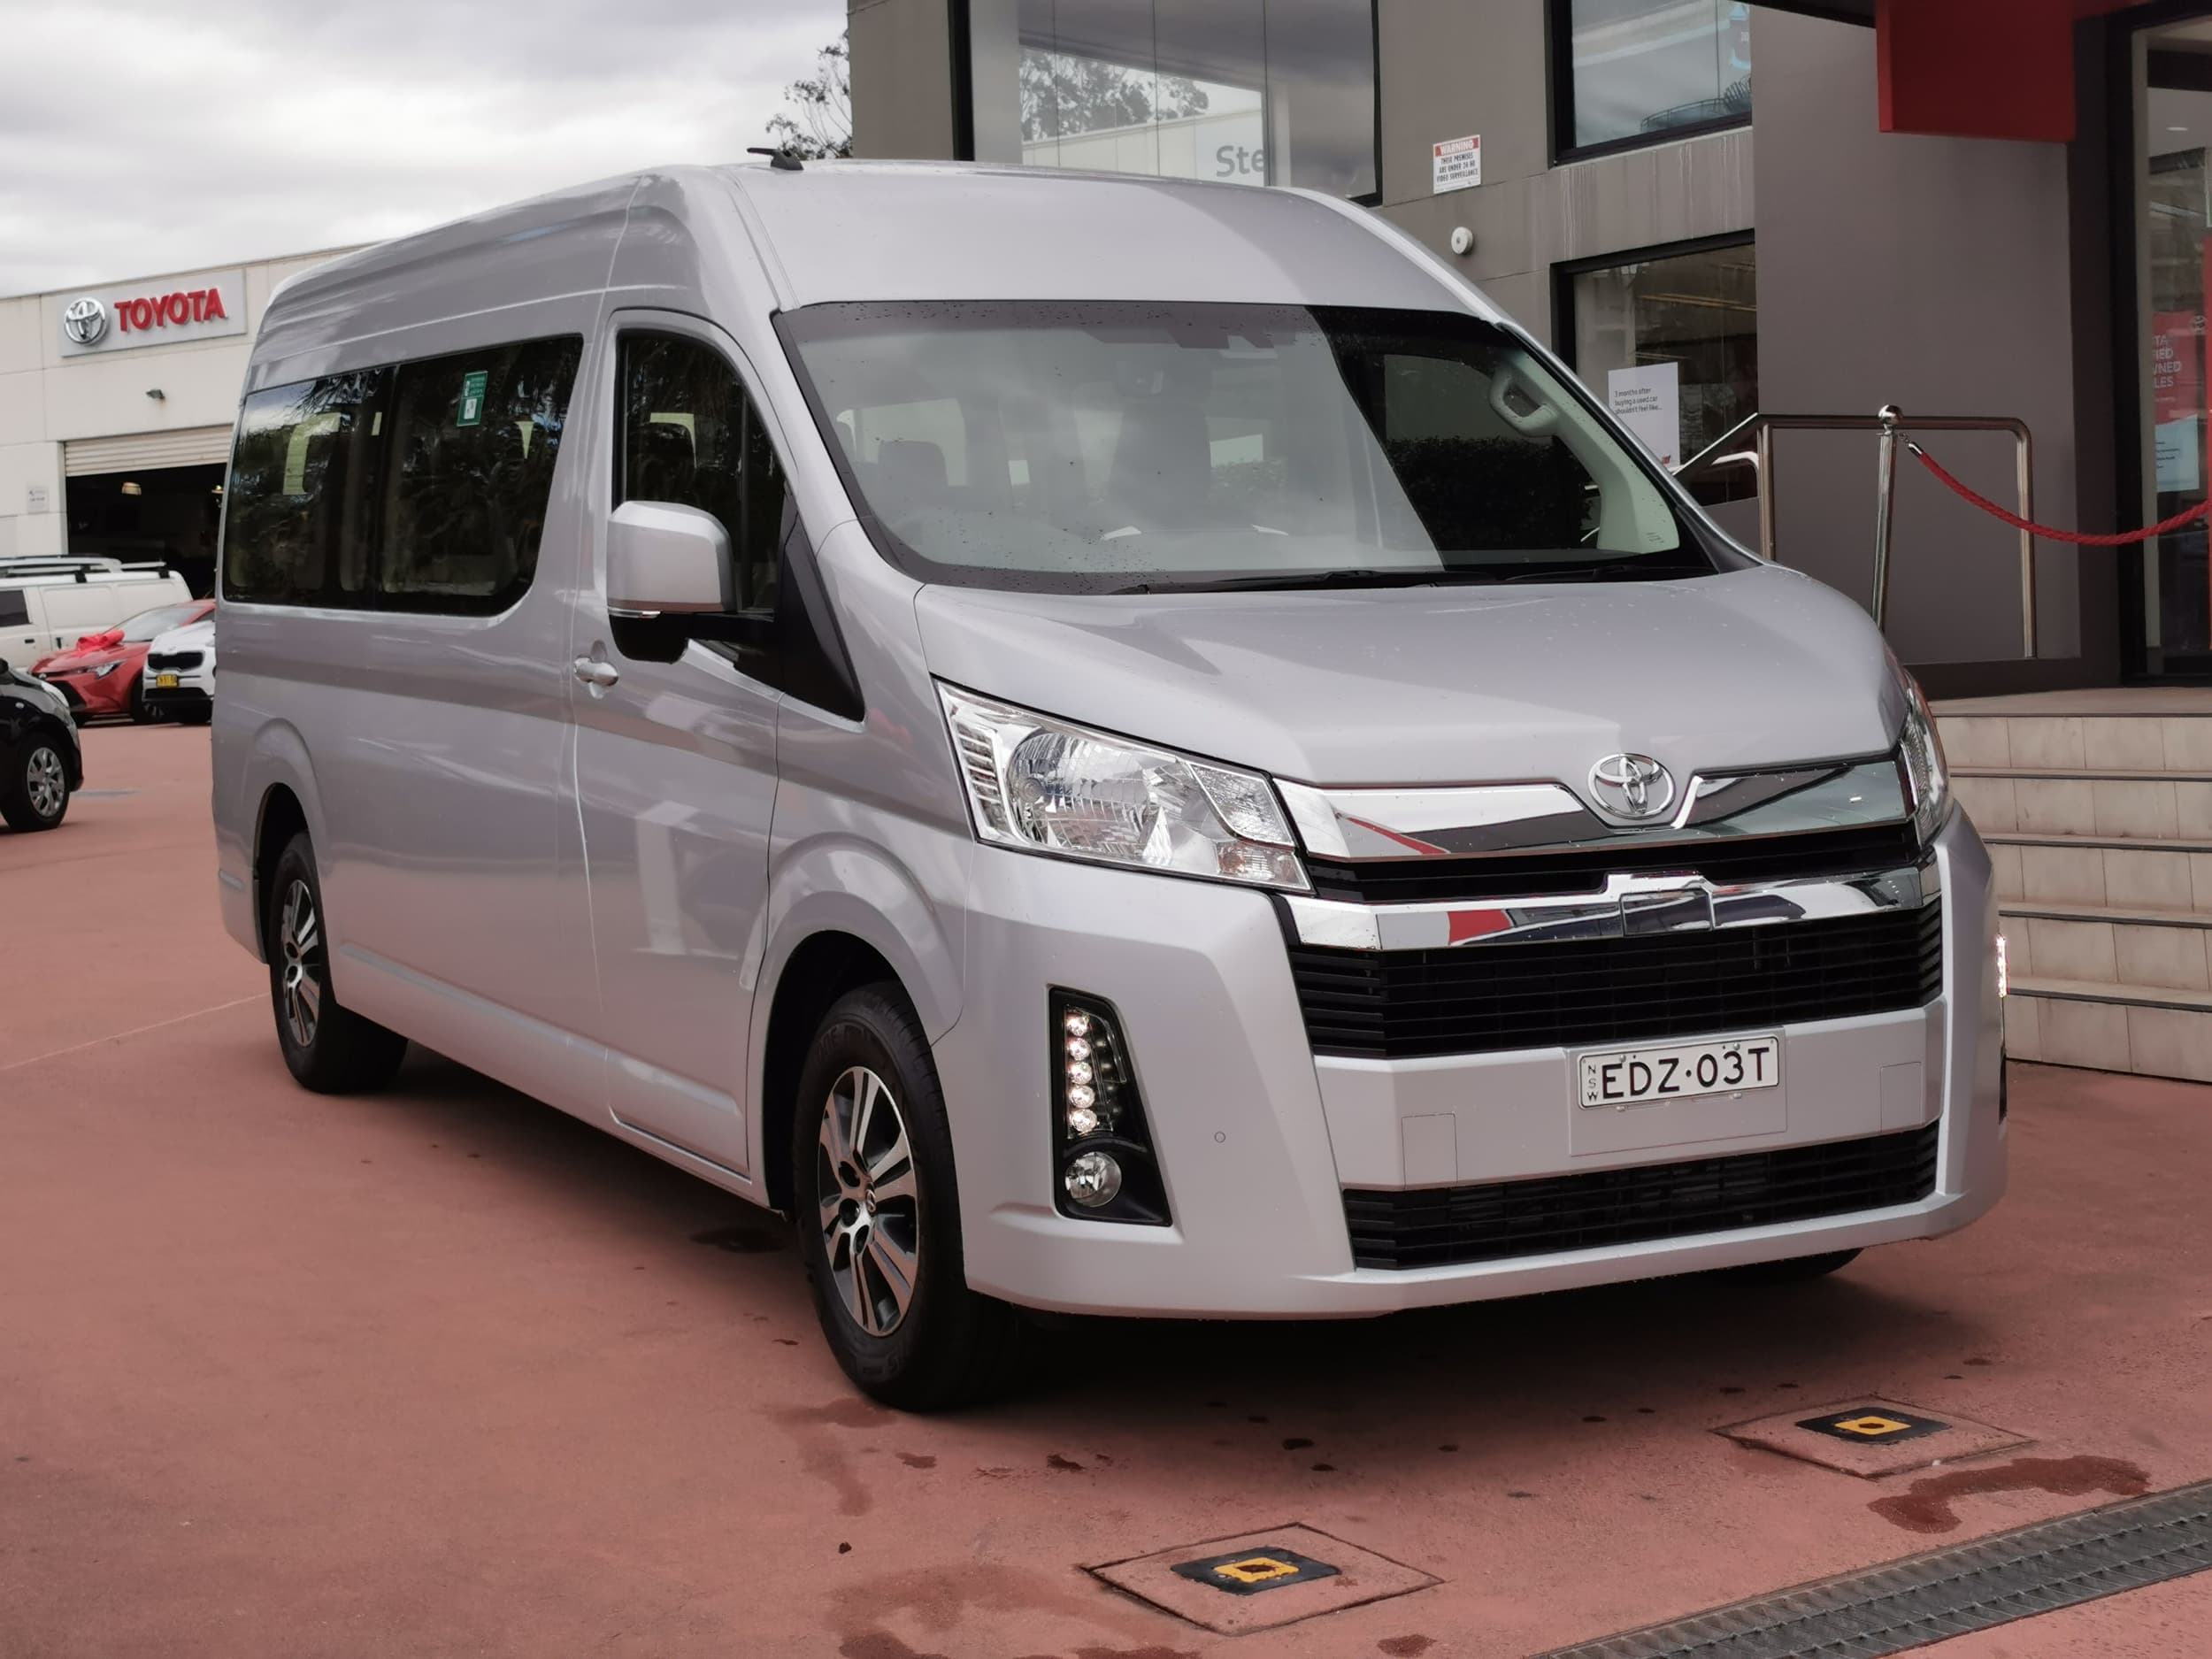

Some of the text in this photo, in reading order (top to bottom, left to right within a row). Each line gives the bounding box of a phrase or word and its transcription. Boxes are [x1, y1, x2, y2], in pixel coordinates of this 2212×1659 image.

[1440, 140, 1473, 155] WARNING
[1448, 163, 1462, 172] UNDER
[114, 288, 227, 333] TOYOTA
[1618, 388, 1638, 397] months
